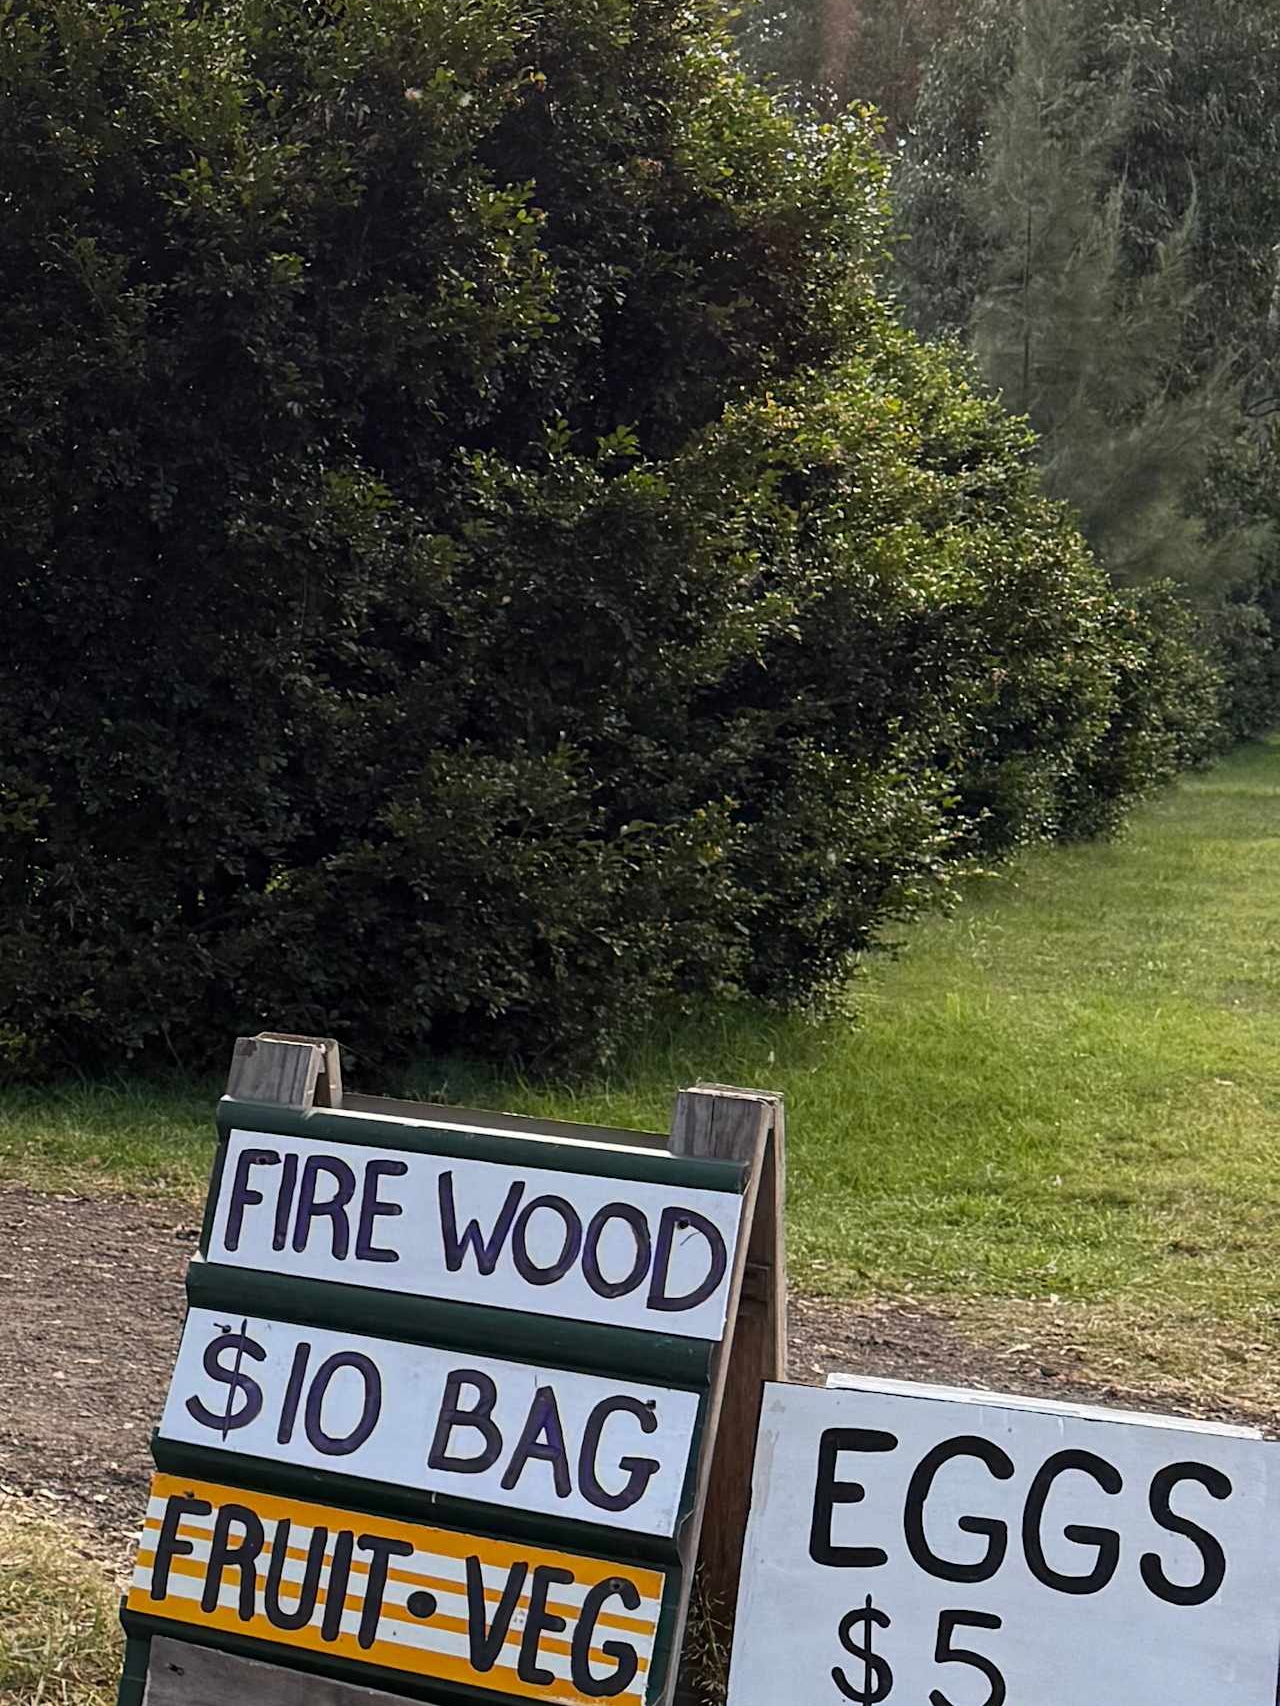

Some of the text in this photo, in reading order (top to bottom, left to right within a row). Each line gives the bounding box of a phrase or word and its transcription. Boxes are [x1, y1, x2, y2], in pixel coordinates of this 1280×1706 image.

[223, 1148, 727, 1313] FIRE WOOD
[184, 1318, 661, 1513] $10 BAG
[808, 1426, 1233, 1607] EGGS
